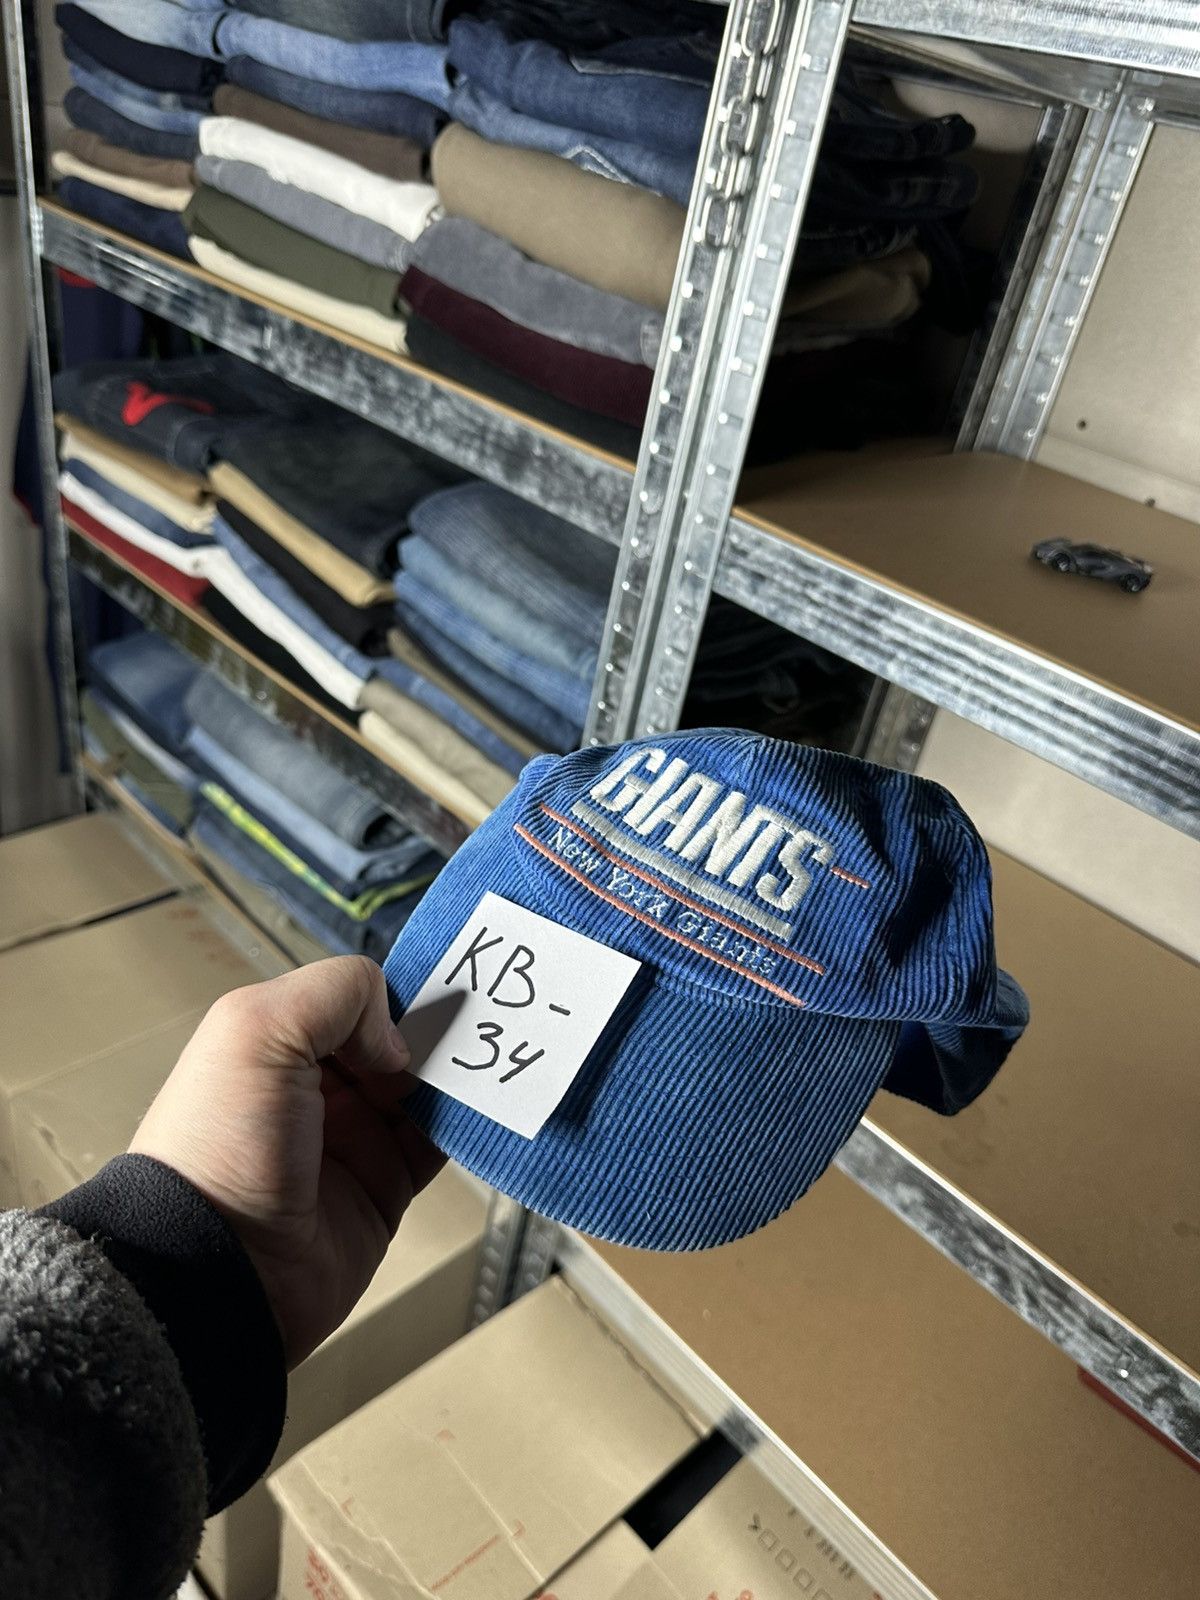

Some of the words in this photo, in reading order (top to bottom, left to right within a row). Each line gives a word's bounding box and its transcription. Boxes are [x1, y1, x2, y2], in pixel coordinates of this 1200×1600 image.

[589, 747, 834, 912] GIANTS
[547, 826, 600, 873] New
[607, 867, 669, 918] York
[677, 911, 777, 974] Giants
[444, 927, 571, 1016] KB-
[451, 1022, 545, 1083] 34
